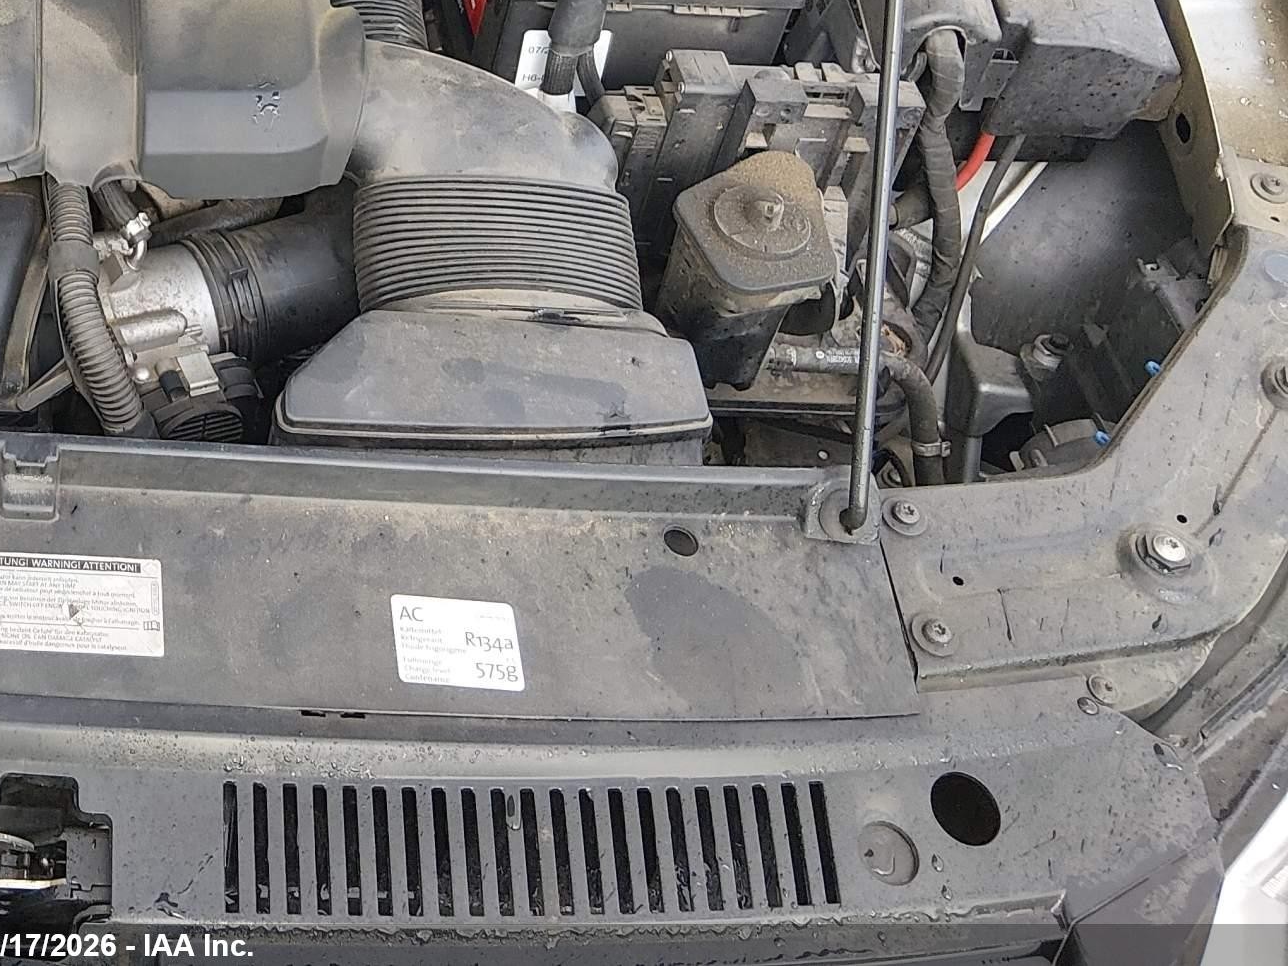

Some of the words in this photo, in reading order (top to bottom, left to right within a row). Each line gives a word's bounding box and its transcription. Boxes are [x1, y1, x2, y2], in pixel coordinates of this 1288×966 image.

[31, 558, 81, 569] WARNING!
[83, 562, 137, 572] ATTENTION!
[400, 606, 424, 622] AC
[465, 631, 513, 653] R134a
[476, 662, 519, 682] 575g
